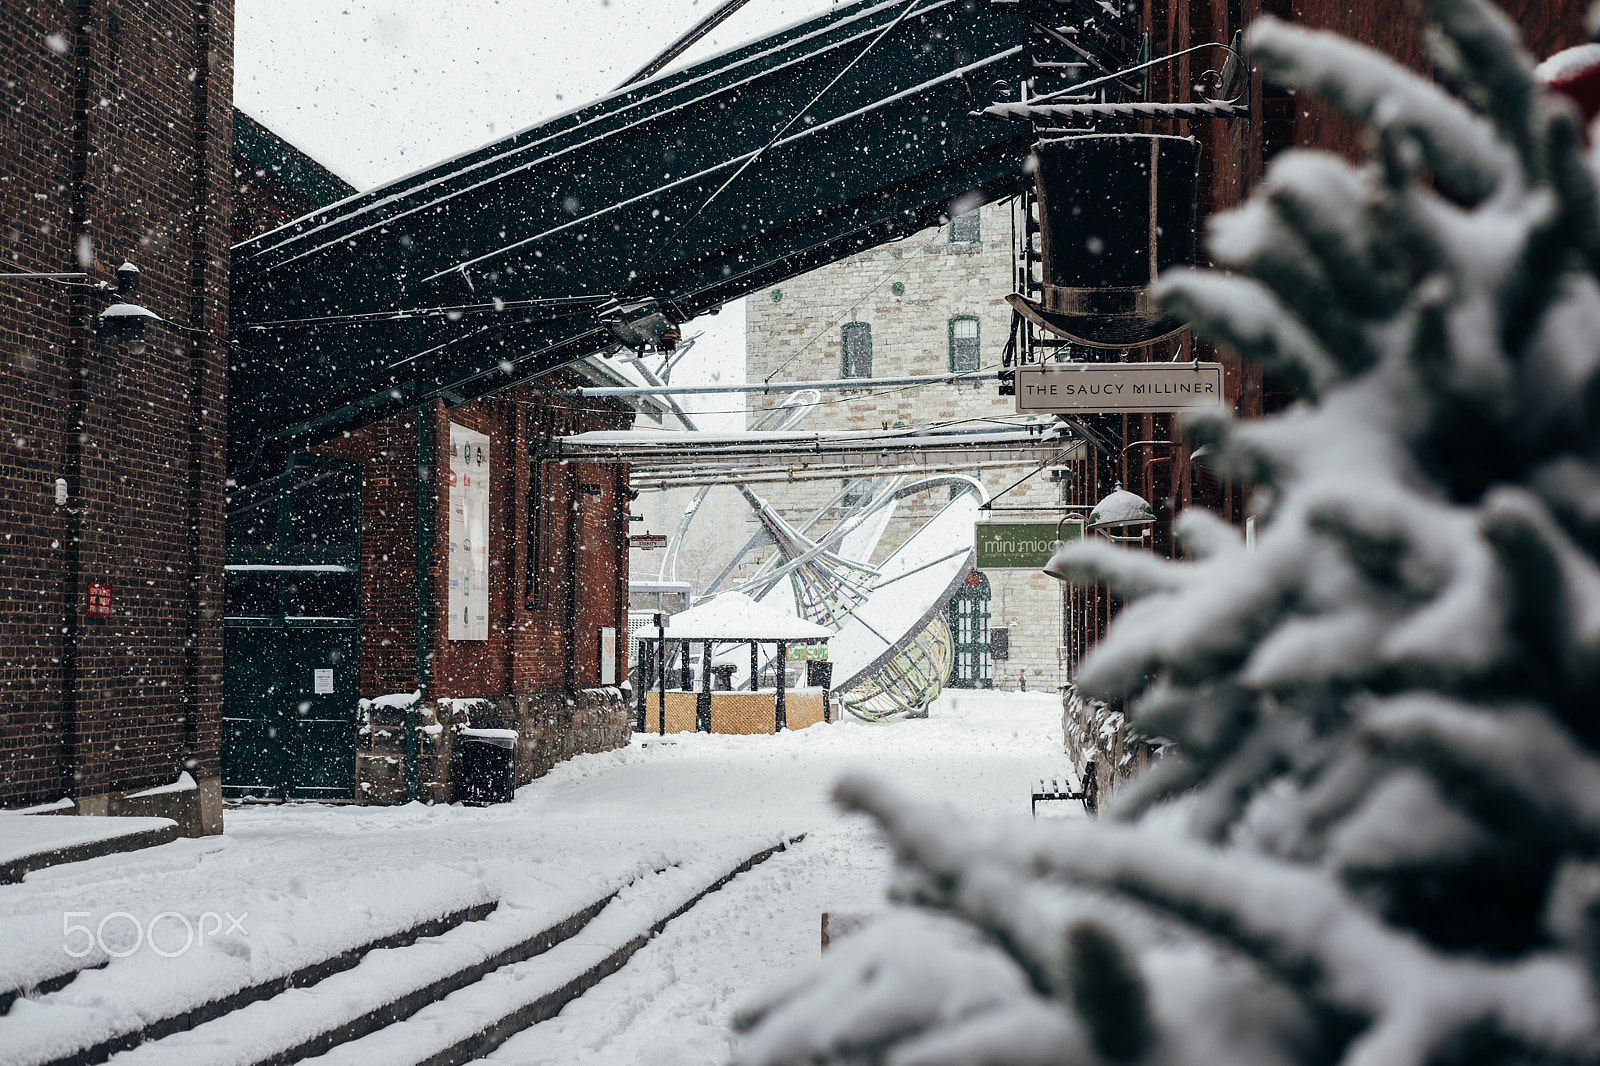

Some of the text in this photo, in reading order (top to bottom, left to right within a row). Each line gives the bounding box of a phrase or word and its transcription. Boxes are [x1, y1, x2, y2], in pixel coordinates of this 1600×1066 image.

[1026, 383, 1214, 395] THE SAUCY MILLINER
[984, 540, 1015, 553] mini
[788, 647, 828, 660] HOT SOUP
